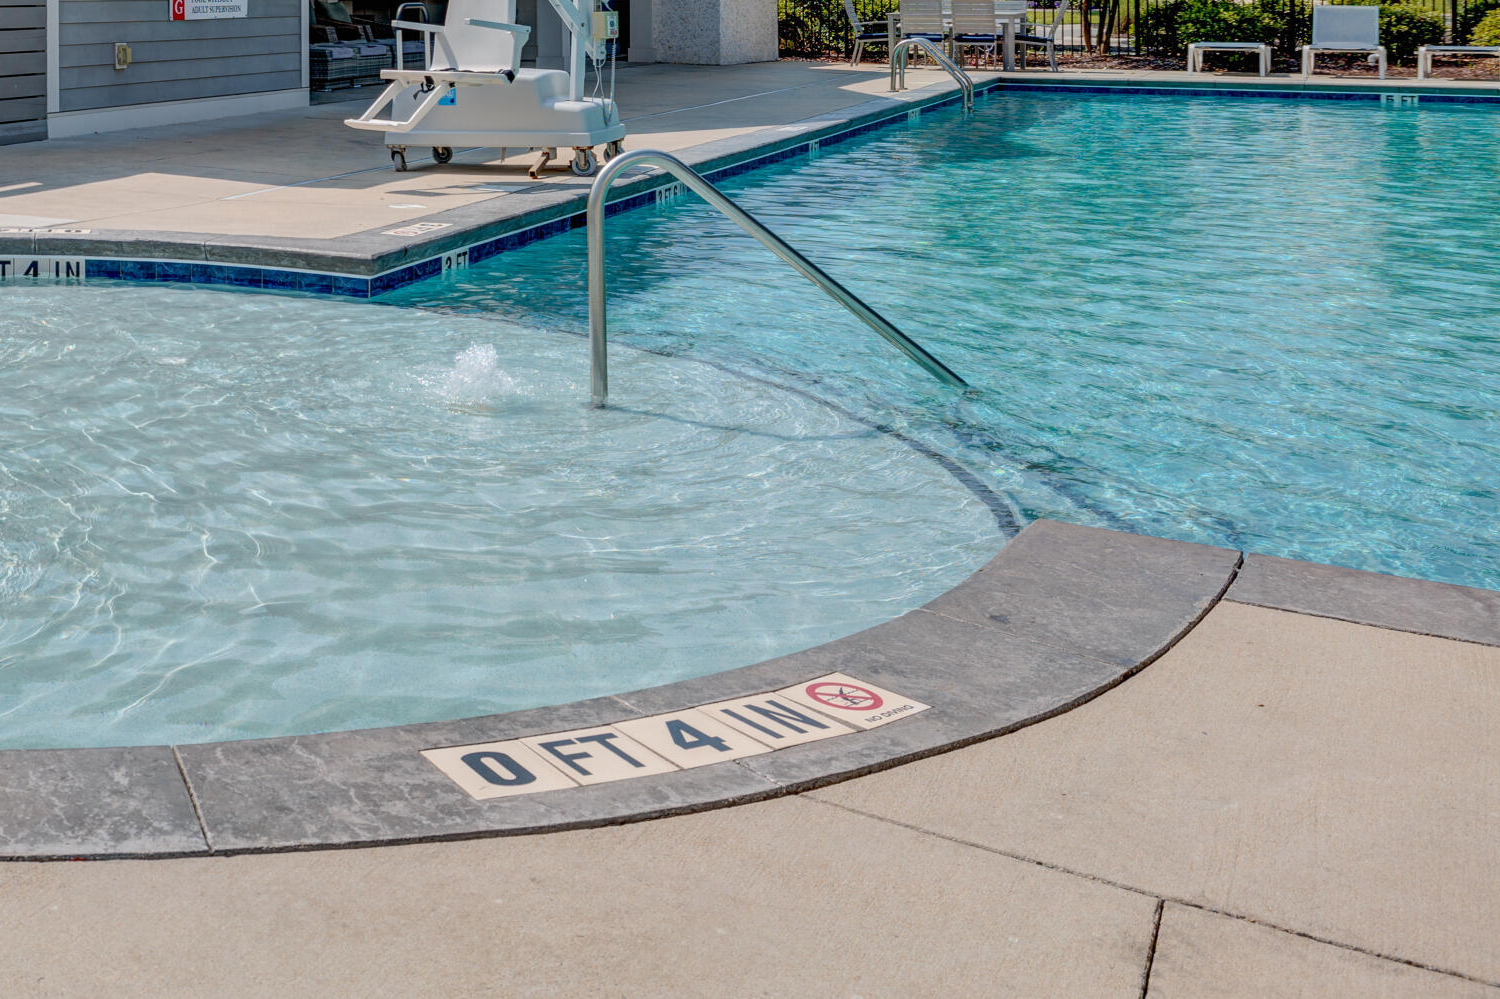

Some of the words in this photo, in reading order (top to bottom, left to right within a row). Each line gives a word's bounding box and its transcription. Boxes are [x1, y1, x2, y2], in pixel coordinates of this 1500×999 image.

[192, 5, 209, 13] ADULT
[209, 5, 241, 13] SUPERVISION
[23, 260, 39, 278] 4
[55, 261, 80, 278] IN
[456, 251, 468, 270] FT
[864, 715, 883, 723] NO
[880, 704, 915, 718] DIVING
[460, 750, 537, 788] 0
[538, 732, 645, 776] FT
[666, 719, 732, 752] 4
[720, 699, 831, 739] IN
